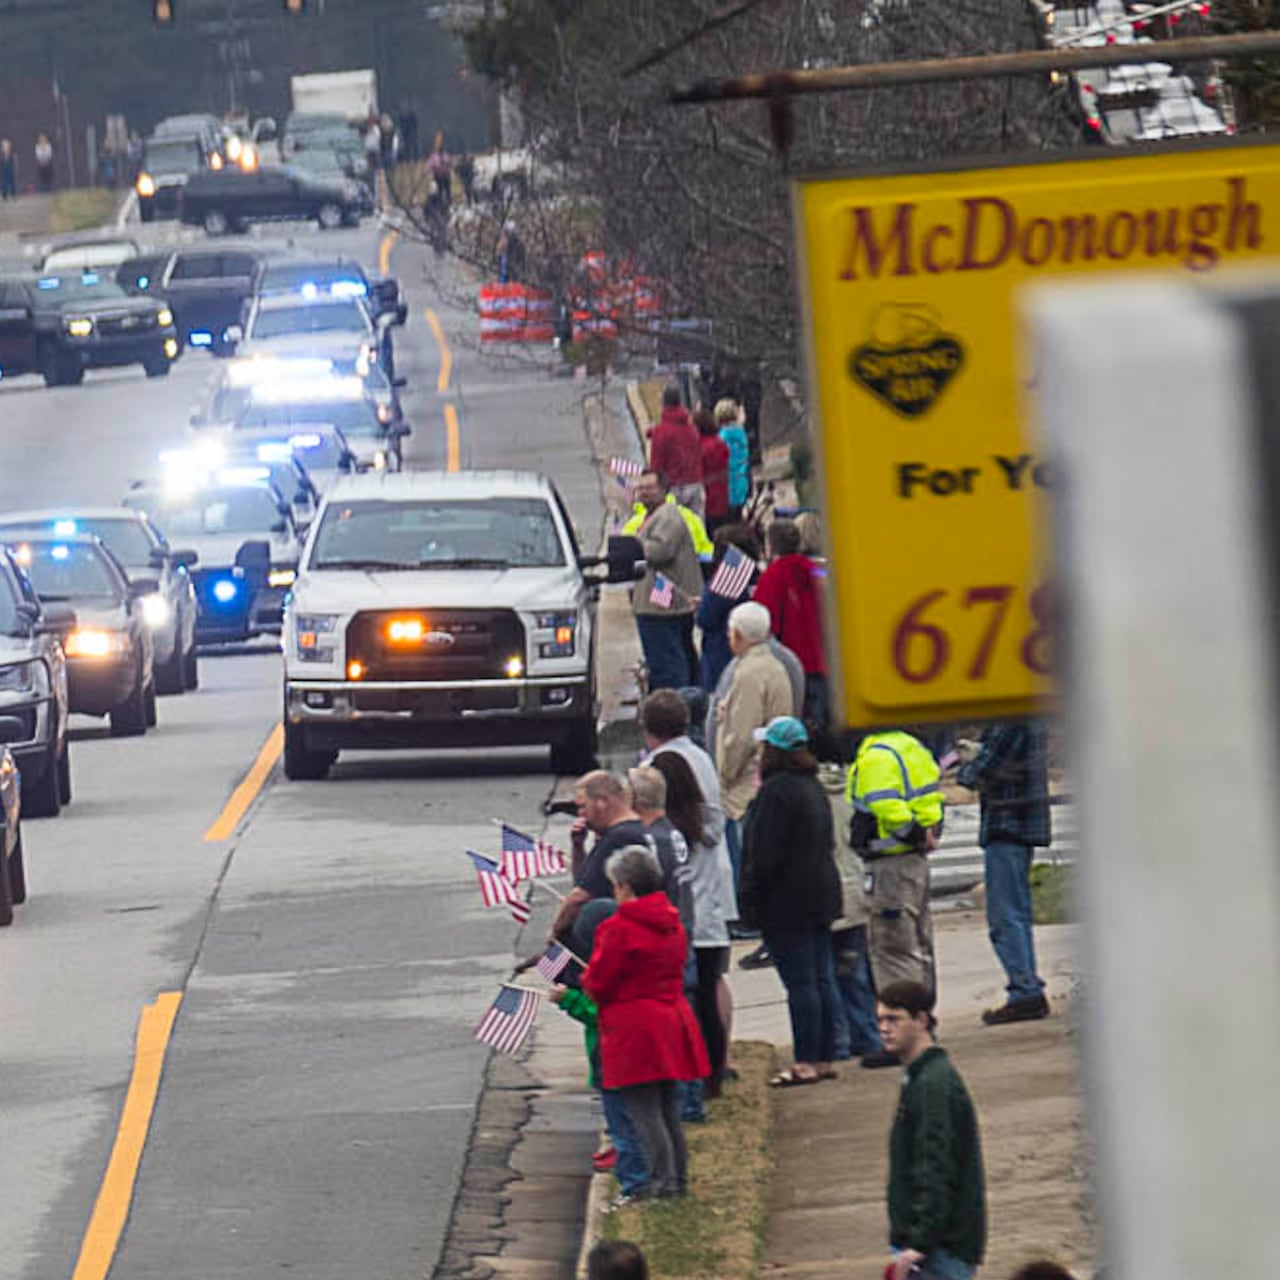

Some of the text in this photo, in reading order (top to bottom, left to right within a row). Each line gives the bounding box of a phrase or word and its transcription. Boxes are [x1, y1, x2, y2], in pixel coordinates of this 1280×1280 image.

[840, 176, 1264, 280] McDonough
[853, 348, 960, 380] SPRING
[898, 463, 980, 498] For
